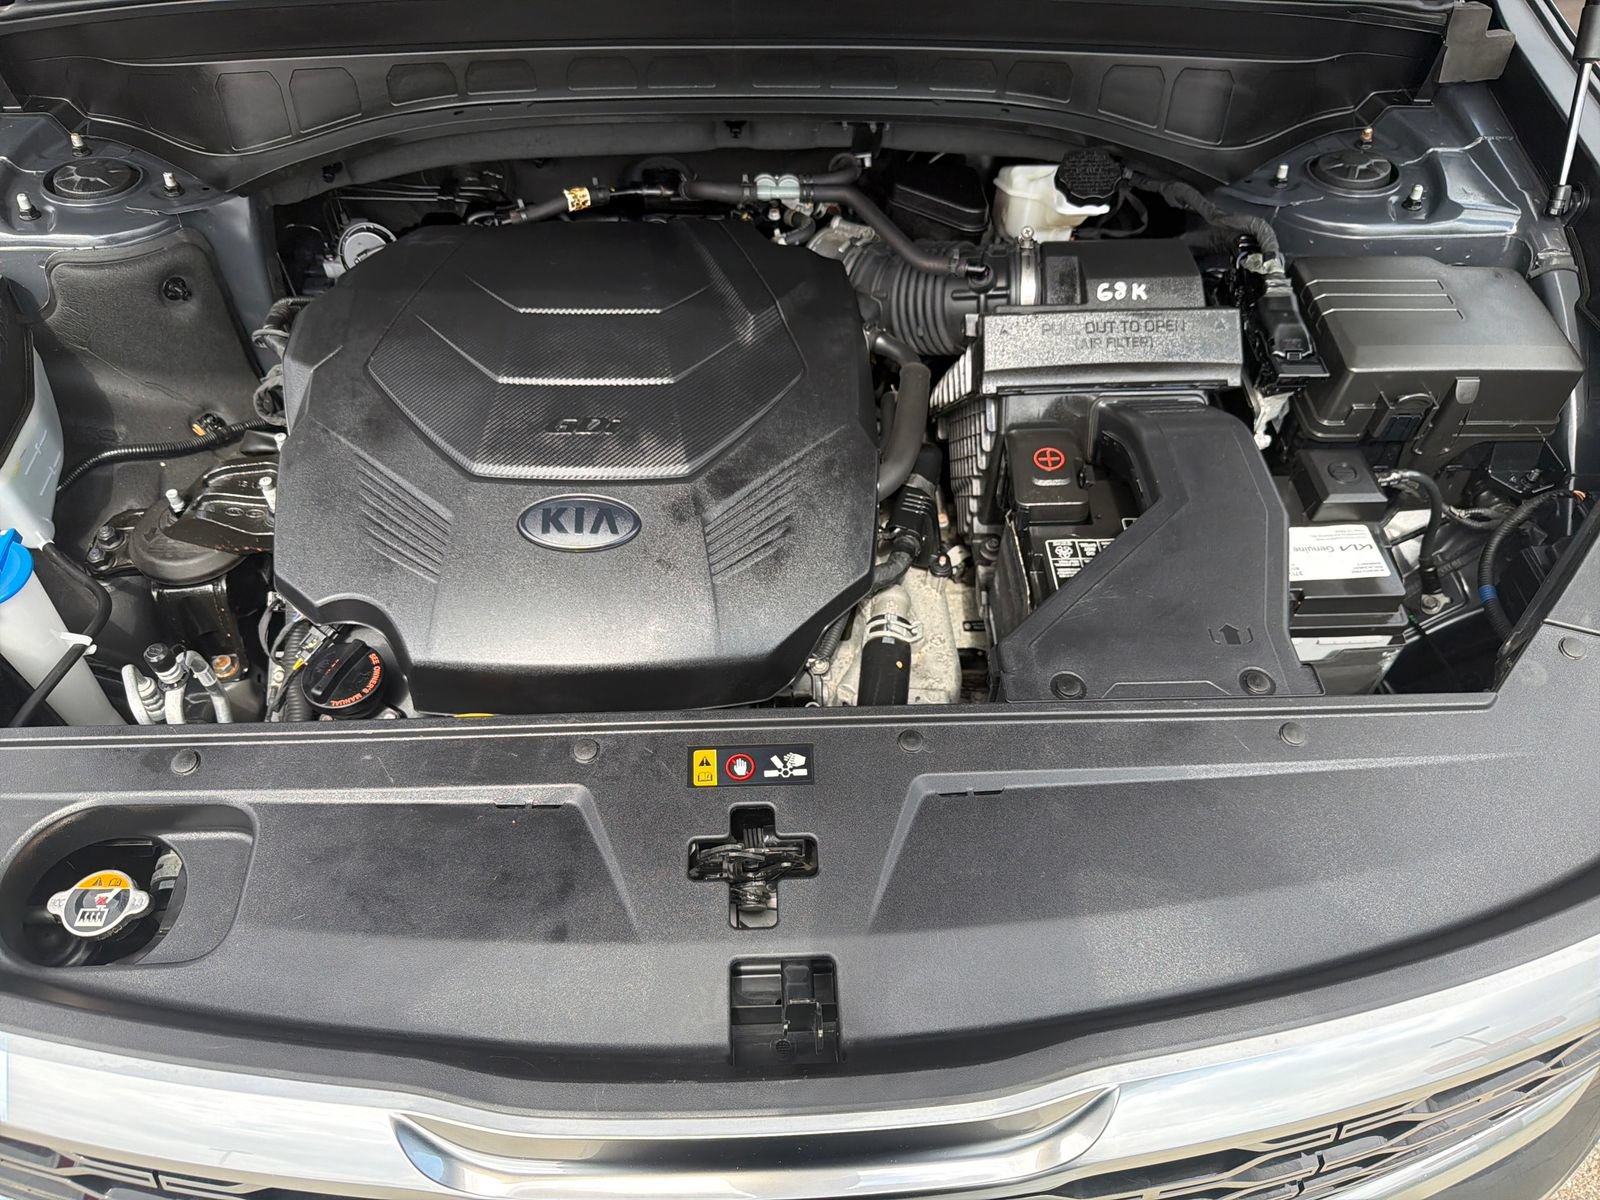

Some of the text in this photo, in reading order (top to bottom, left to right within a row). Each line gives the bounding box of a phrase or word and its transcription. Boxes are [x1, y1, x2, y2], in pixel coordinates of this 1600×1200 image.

[1085, 320, 1116, 335] OUT
[1120, 320, 1140, 333] TO
[1144, 319, 1186, 333] OPEN
[541, 507, 620, 535] KIA
[1293, 543, 1373, 553] KIA Genuine
[330, 693, 363, 707] MANUAL
